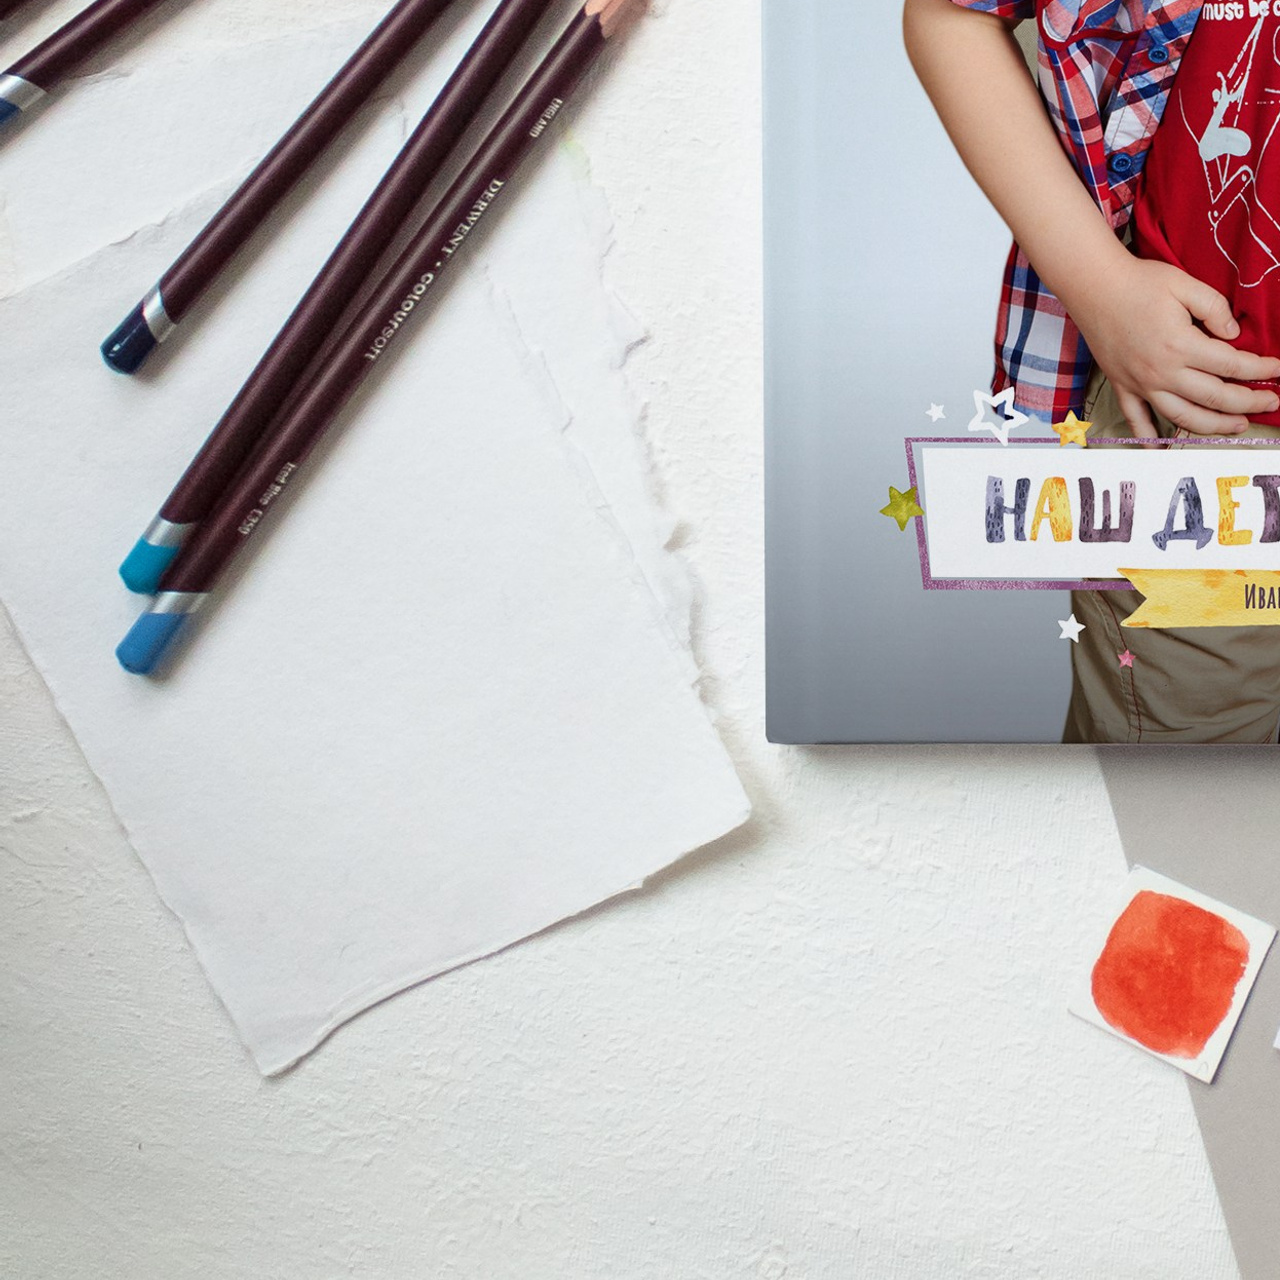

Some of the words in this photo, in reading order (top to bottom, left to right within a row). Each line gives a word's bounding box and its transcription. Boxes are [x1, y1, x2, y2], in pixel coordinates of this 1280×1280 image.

[1202, 1, 1244, 22] must
[529, 97, 564, 138] ENGLAND
[441, 178, 506, 257] DERWENT
[364, 271, 435, 362] coloursoft
[985, 474, 1137, 545] НАШ
